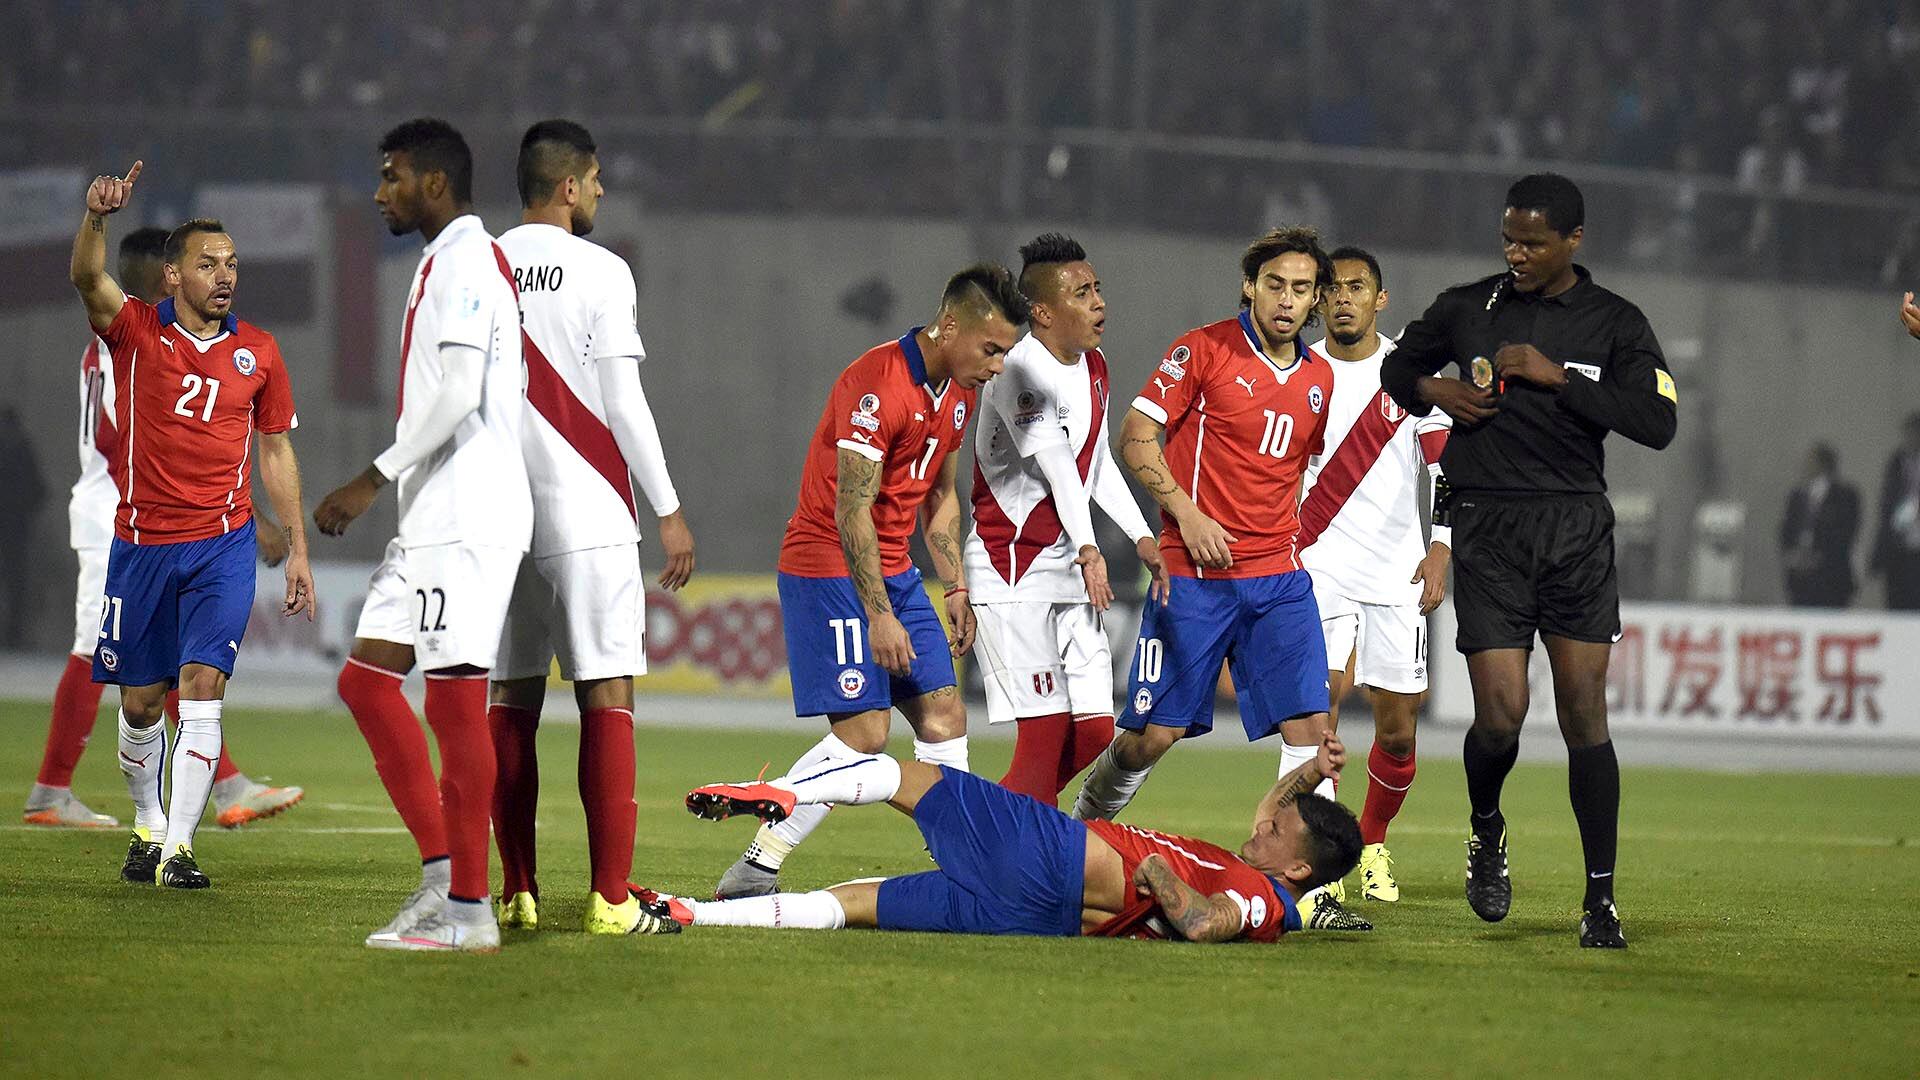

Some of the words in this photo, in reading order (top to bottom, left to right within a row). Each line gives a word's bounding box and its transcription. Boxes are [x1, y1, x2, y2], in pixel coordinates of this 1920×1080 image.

[174, 372, 221, 423] 21
[1258, 408, 1295, 459] 10
[99, 594, 122, 641] 21
[416, 588, 446, 632] 22
[829, 617, 864, 665] 11
[1137, 637, 1163, 683] 10
